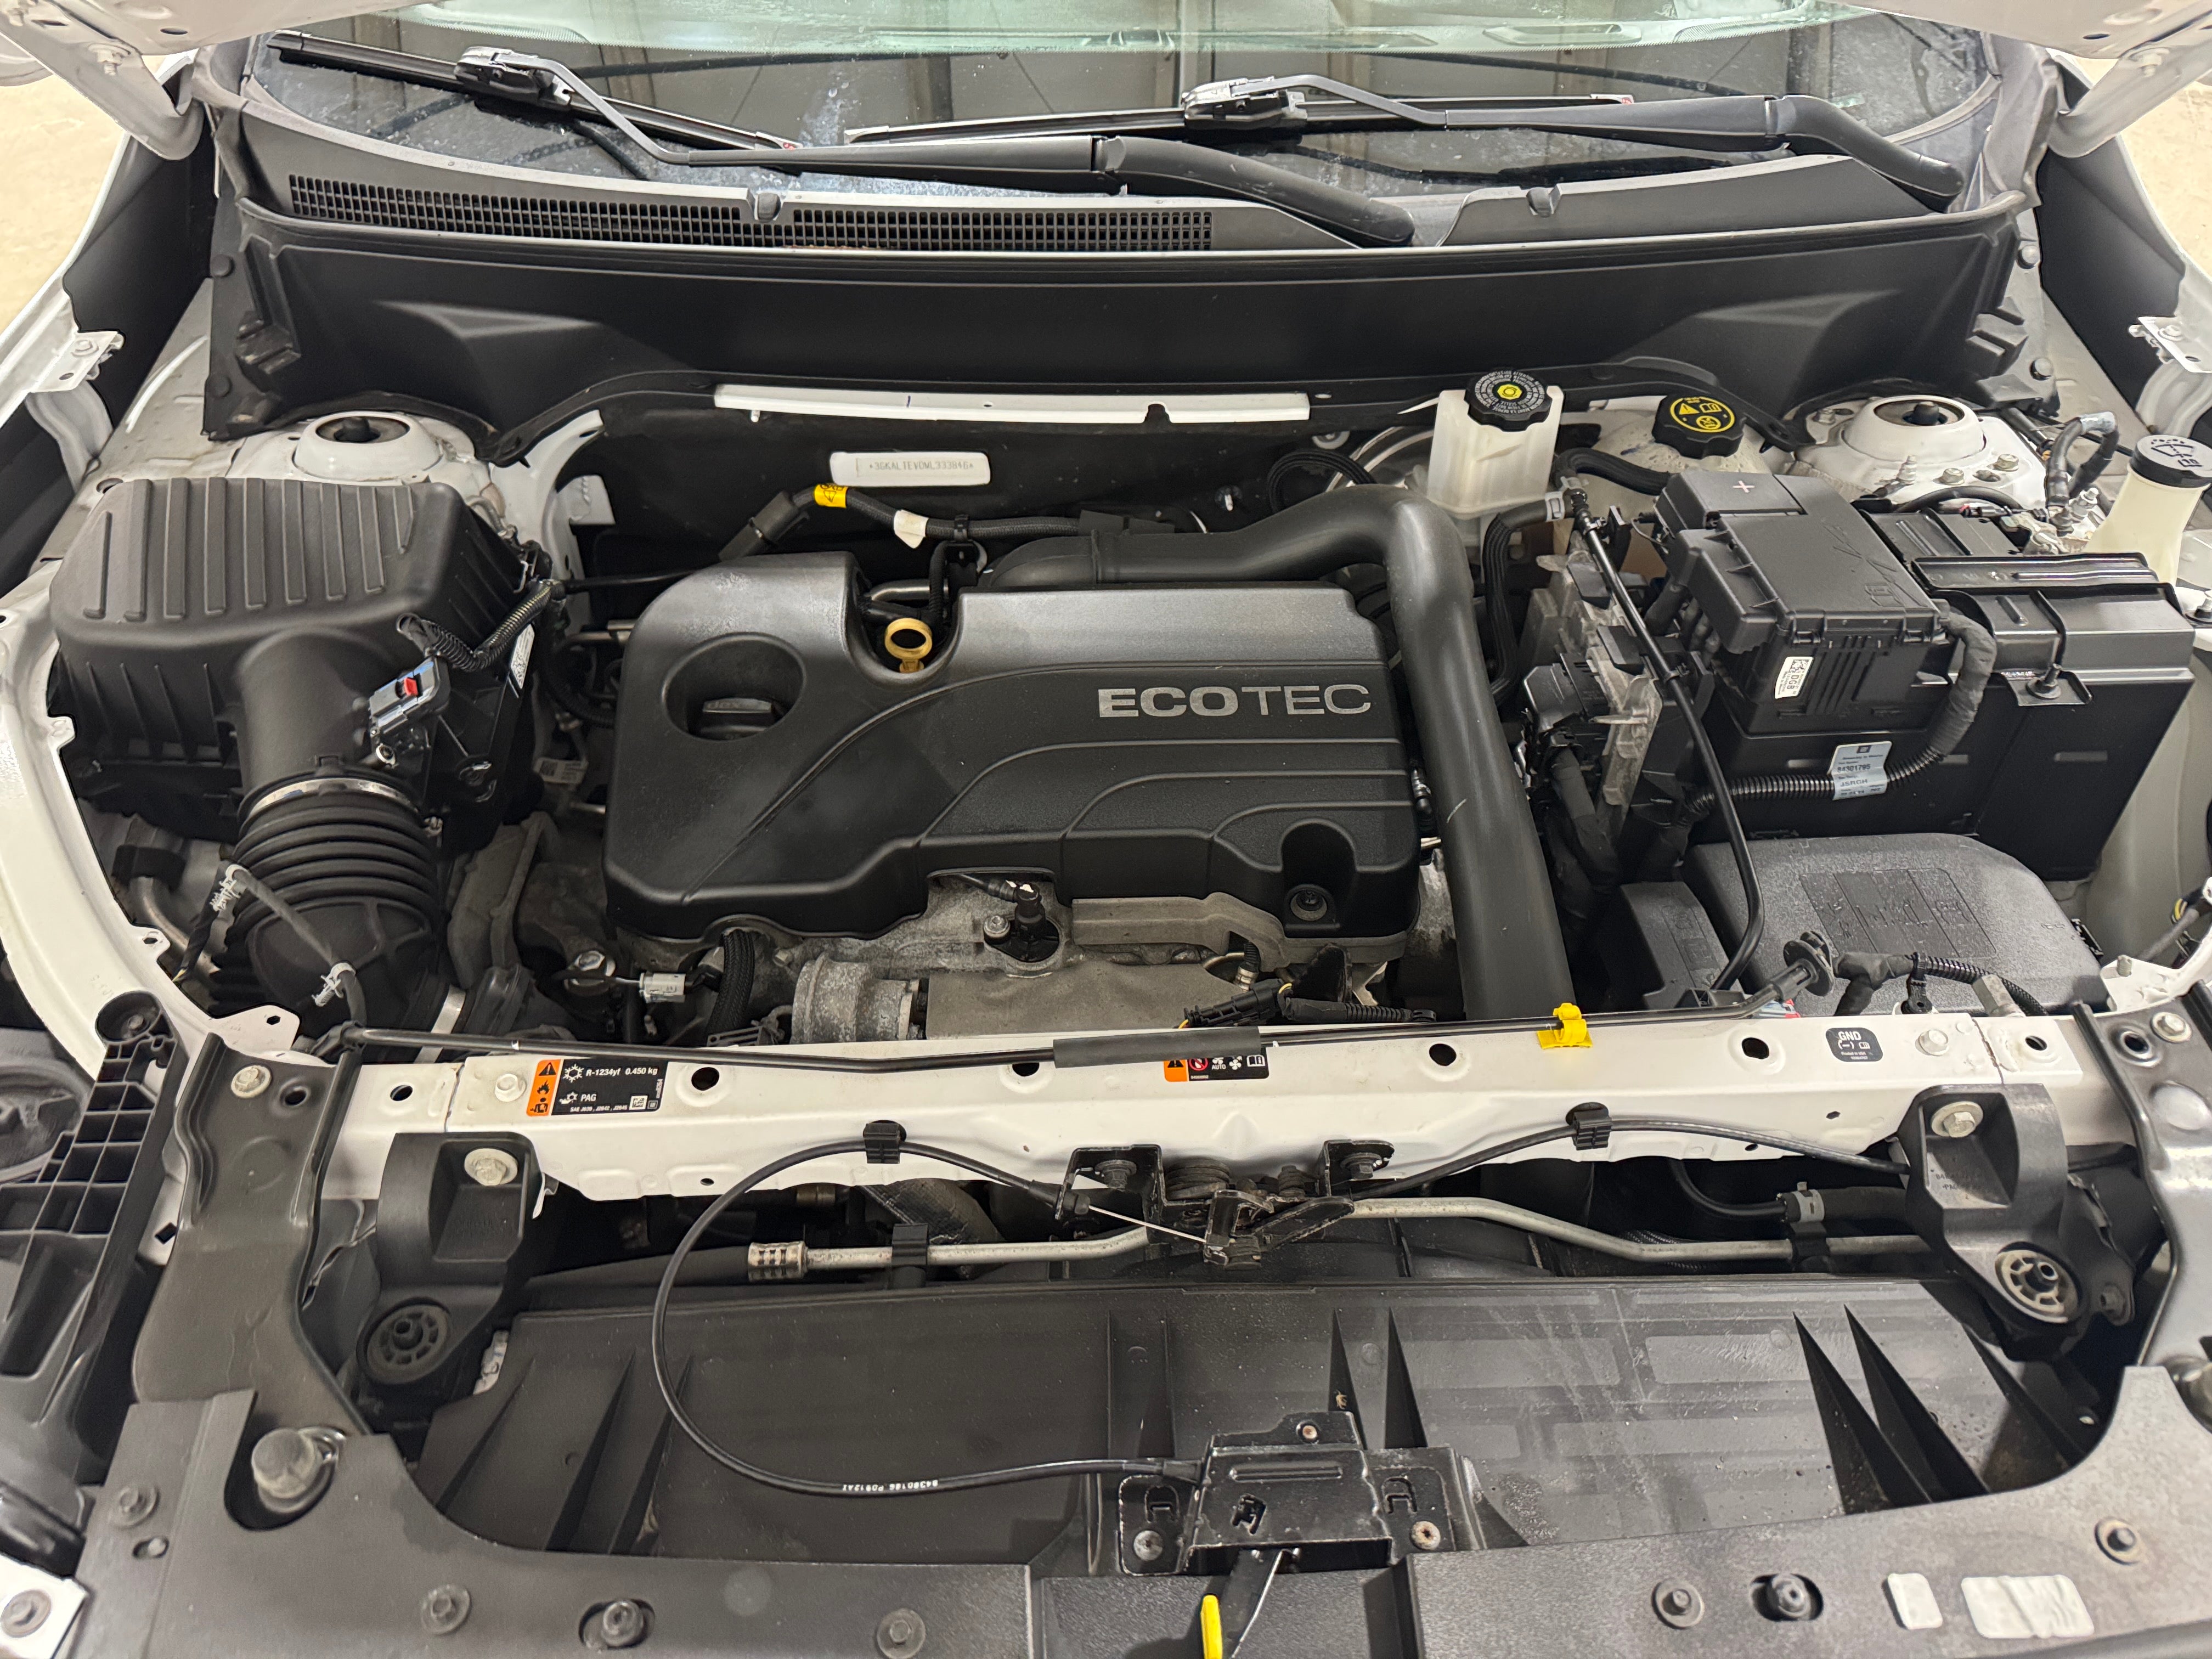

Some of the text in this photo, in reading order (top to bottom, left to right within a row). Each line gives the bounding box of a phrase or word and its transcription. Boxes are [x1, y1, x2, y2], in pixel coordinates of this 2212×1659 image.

[1787, 675, 1799, 690] DGB
[1097, 684, 1372, 718] ECOTEC
[1840, 778, 1868, 787] JSRGH
[1838, 1031, 1861, 1041] GND
[585, 1066, 658, 1077] R-1234yf 0.450 kg
[580, 1093, 597, 1102] PAG
